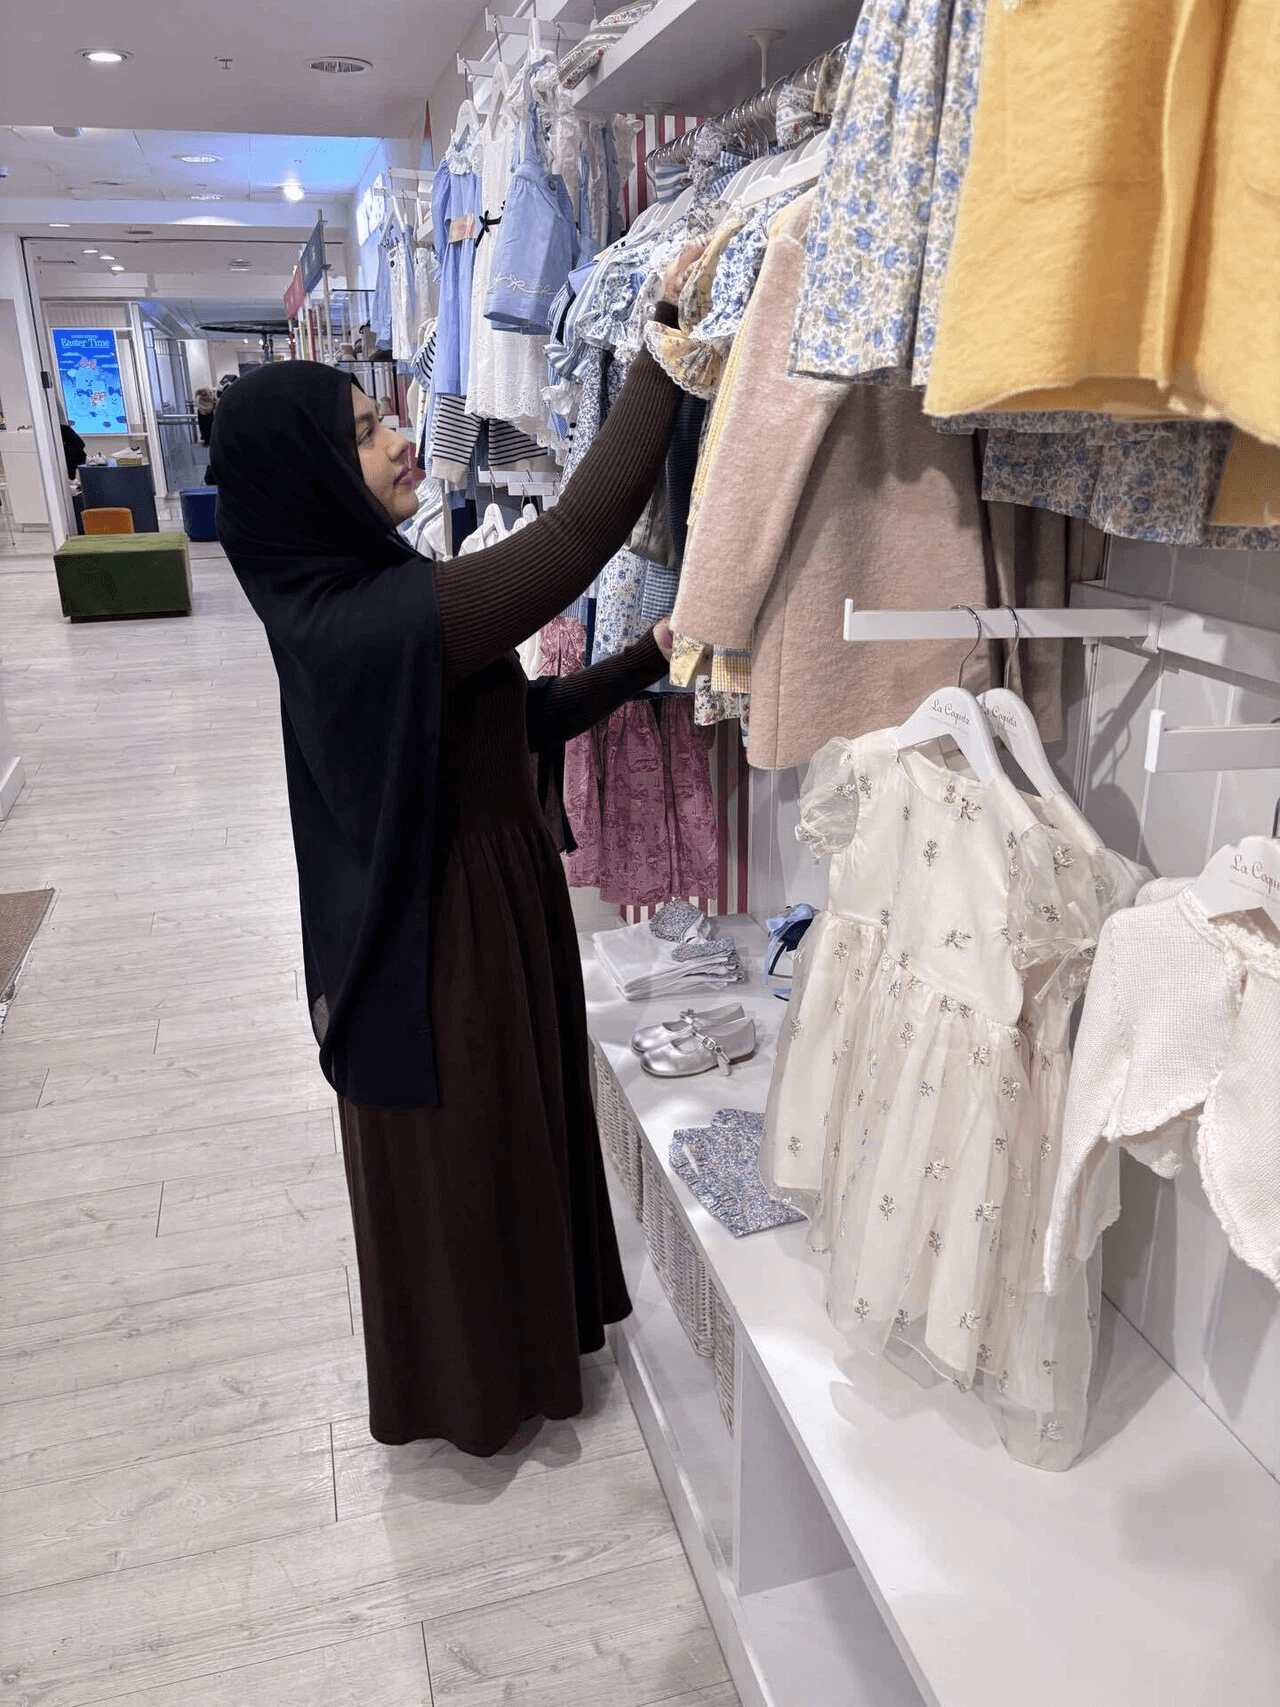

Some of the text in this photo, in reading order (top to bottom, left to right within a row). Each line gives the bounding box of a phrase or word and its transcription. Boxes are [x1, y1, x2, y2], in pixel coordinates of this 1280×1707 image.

[61, 338, 110, 348] Easter Time
[1230, 854, 1248, 875] La
